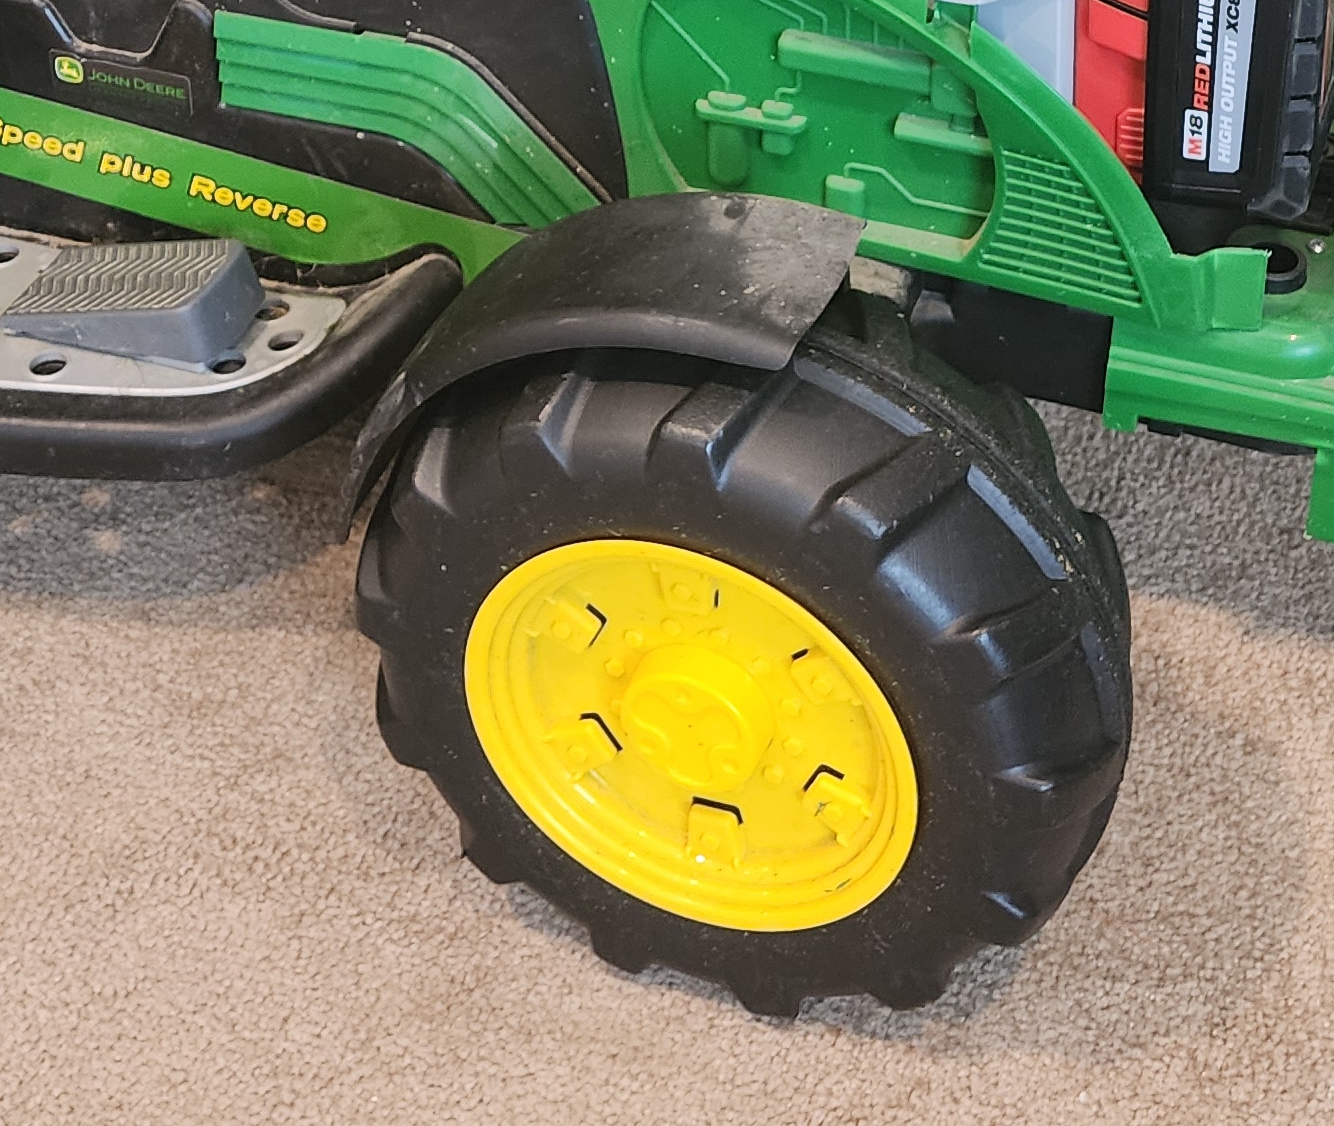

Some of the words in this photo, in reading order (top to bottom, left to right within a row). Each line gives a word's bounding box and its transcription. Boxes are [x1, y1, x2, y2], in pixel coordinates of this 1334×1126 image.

[88, 68, 130, 88] JOHN
[133, 77, 187, 100] DEERE
[1220, 35, 1238, 113] OUTPUT
[1188, 113, 1204, 156] M18
[1217, 114, 1233, 165] HIGH
[97, 151, 172, 190] plus
[187, 172, 329, 235] Reverse
